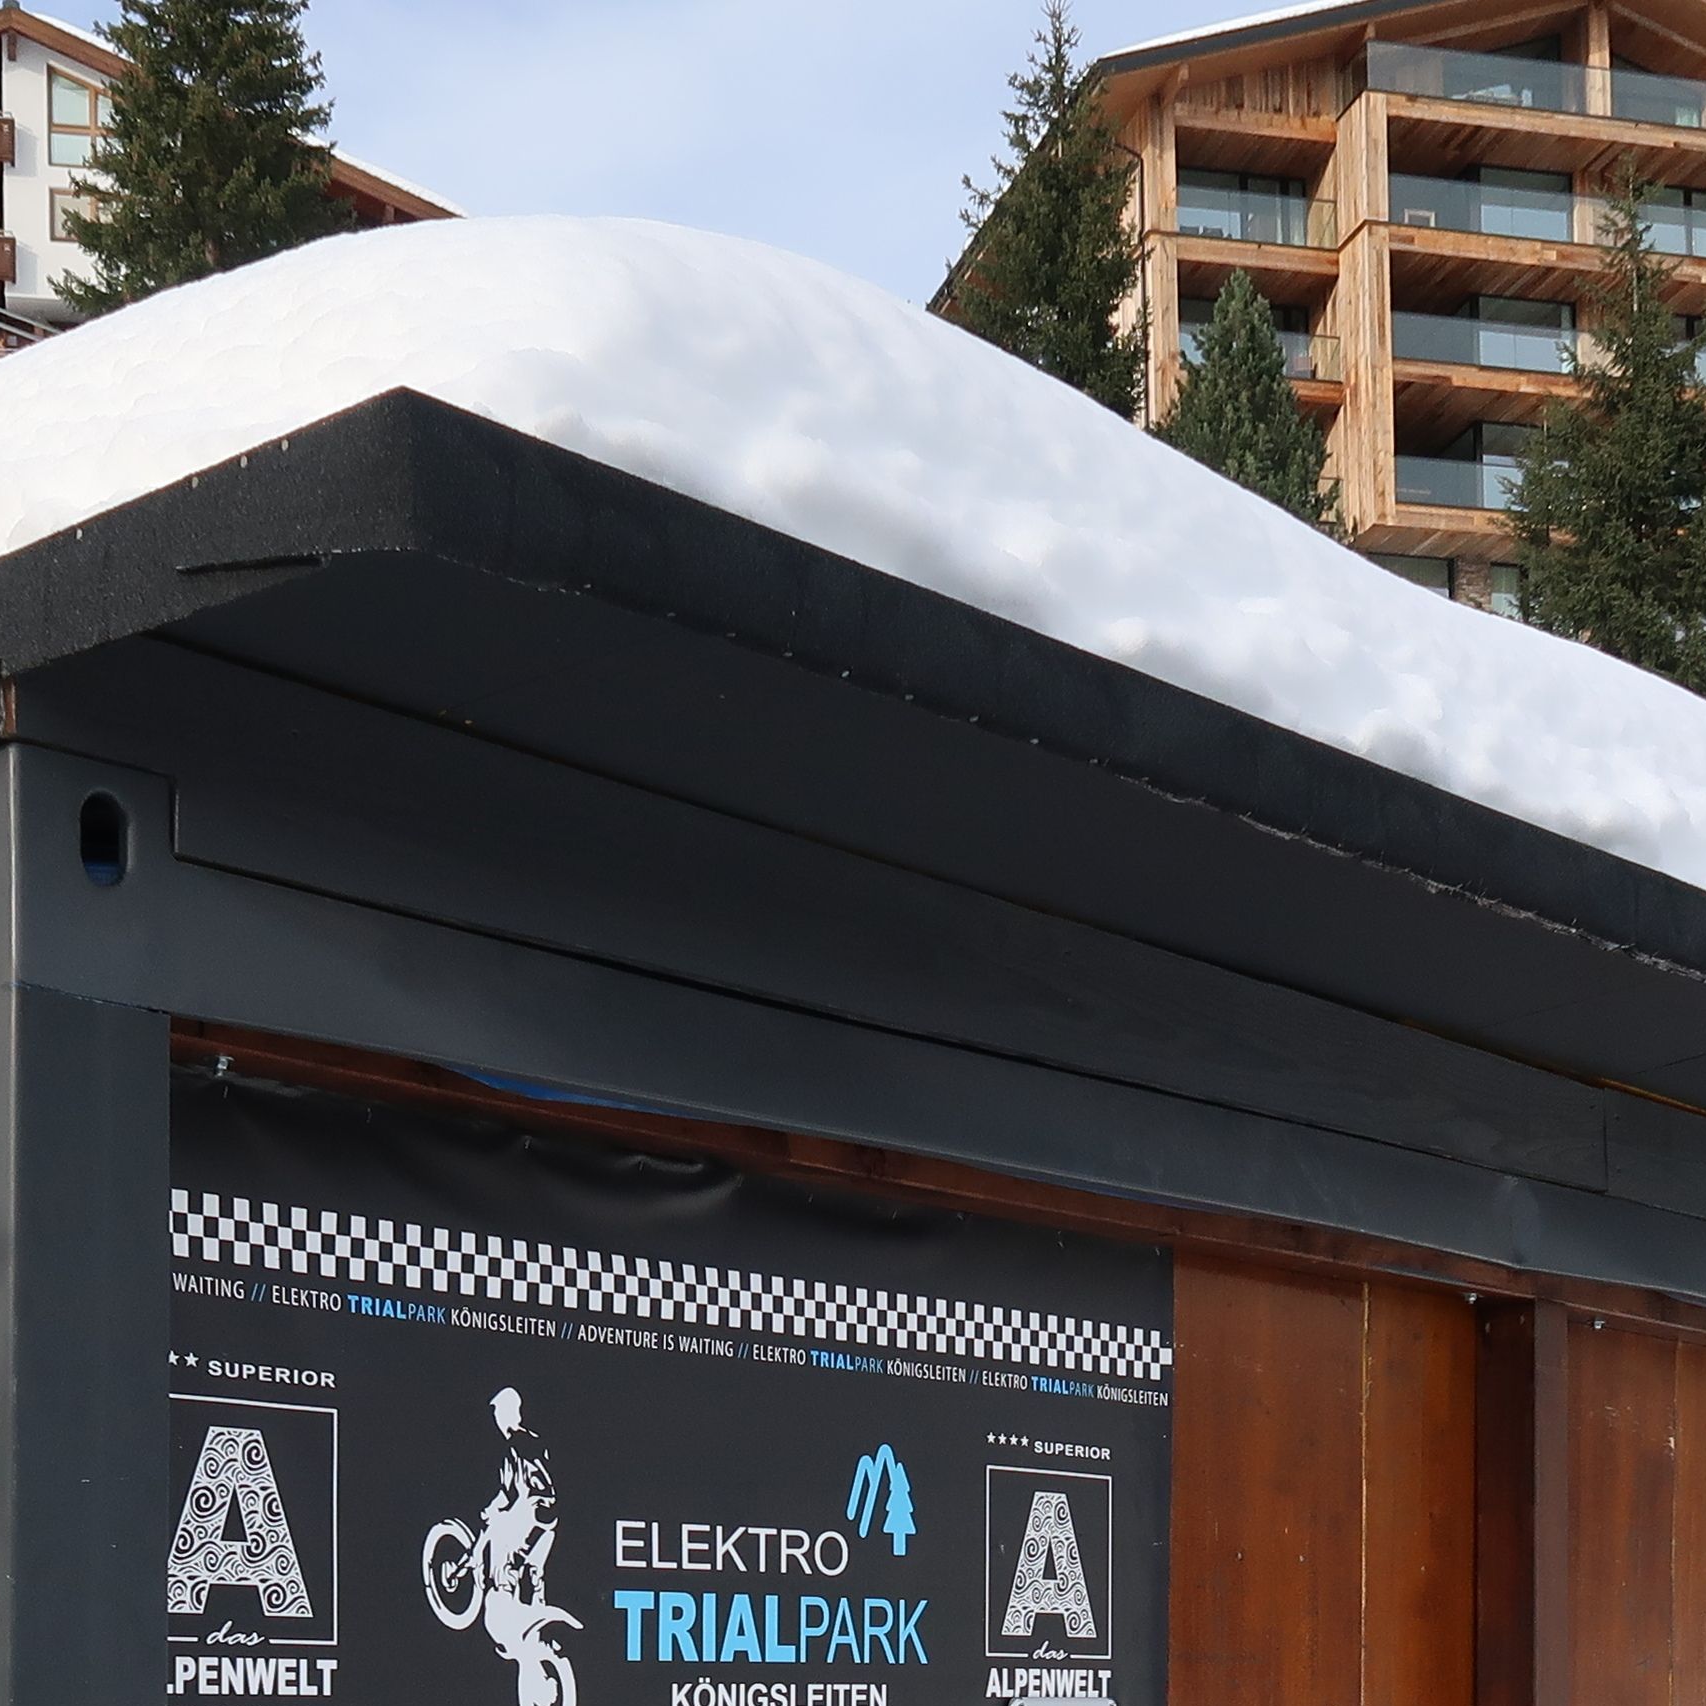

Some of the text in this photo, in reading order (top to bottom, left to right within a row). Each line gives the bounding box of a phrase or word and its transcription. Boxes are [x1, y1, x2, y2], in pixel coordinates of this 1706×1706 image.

[172, 1272, 245, 1300] WAITING
[272, 1285, 342, 1312] ELEKTRO
[347, 1294, 446, 1325] TRIALPARK
[451, 1307, 556, 1338] KÖNIGSLEITEN
[577, 1324, 659, 1350] ADVENTURE
[663, 1334, 674, 1351] IS
[679, 1336, 734, 1358] WAITING
[752, 1344, 806, 1366] ELEKTRO
[810, 1350, 884, 1374] TRIALPARK
[887, 1359, 966, 1383] KÖNIGSLEITEN
[982, 1371, 1028, 1390] ELEKTRO
[1031, 1375, 1094, 1398] TRIALPARK
[1097, 1384, 1169, 1407] KÖNIGSLEITEN
[207, 1359, 336, 1388] SUPERIOR
[1033, 1440, 1111, 1461] SUPERIOR
[167, 1426, 314, 1618] A
[615, 1519, 849, 1577] ELEKTRO
[1001, 1491, 1097, 1638] A
[206, 1620, 266, 1646] das
[614, 1590, 929, 1664] TRIALPARK
[1032, 1641, 1069, 1660] das
[166, 1656, 338, 1696] PENWELT
[985, 1667, 1112, 1698] ALPENWELT
